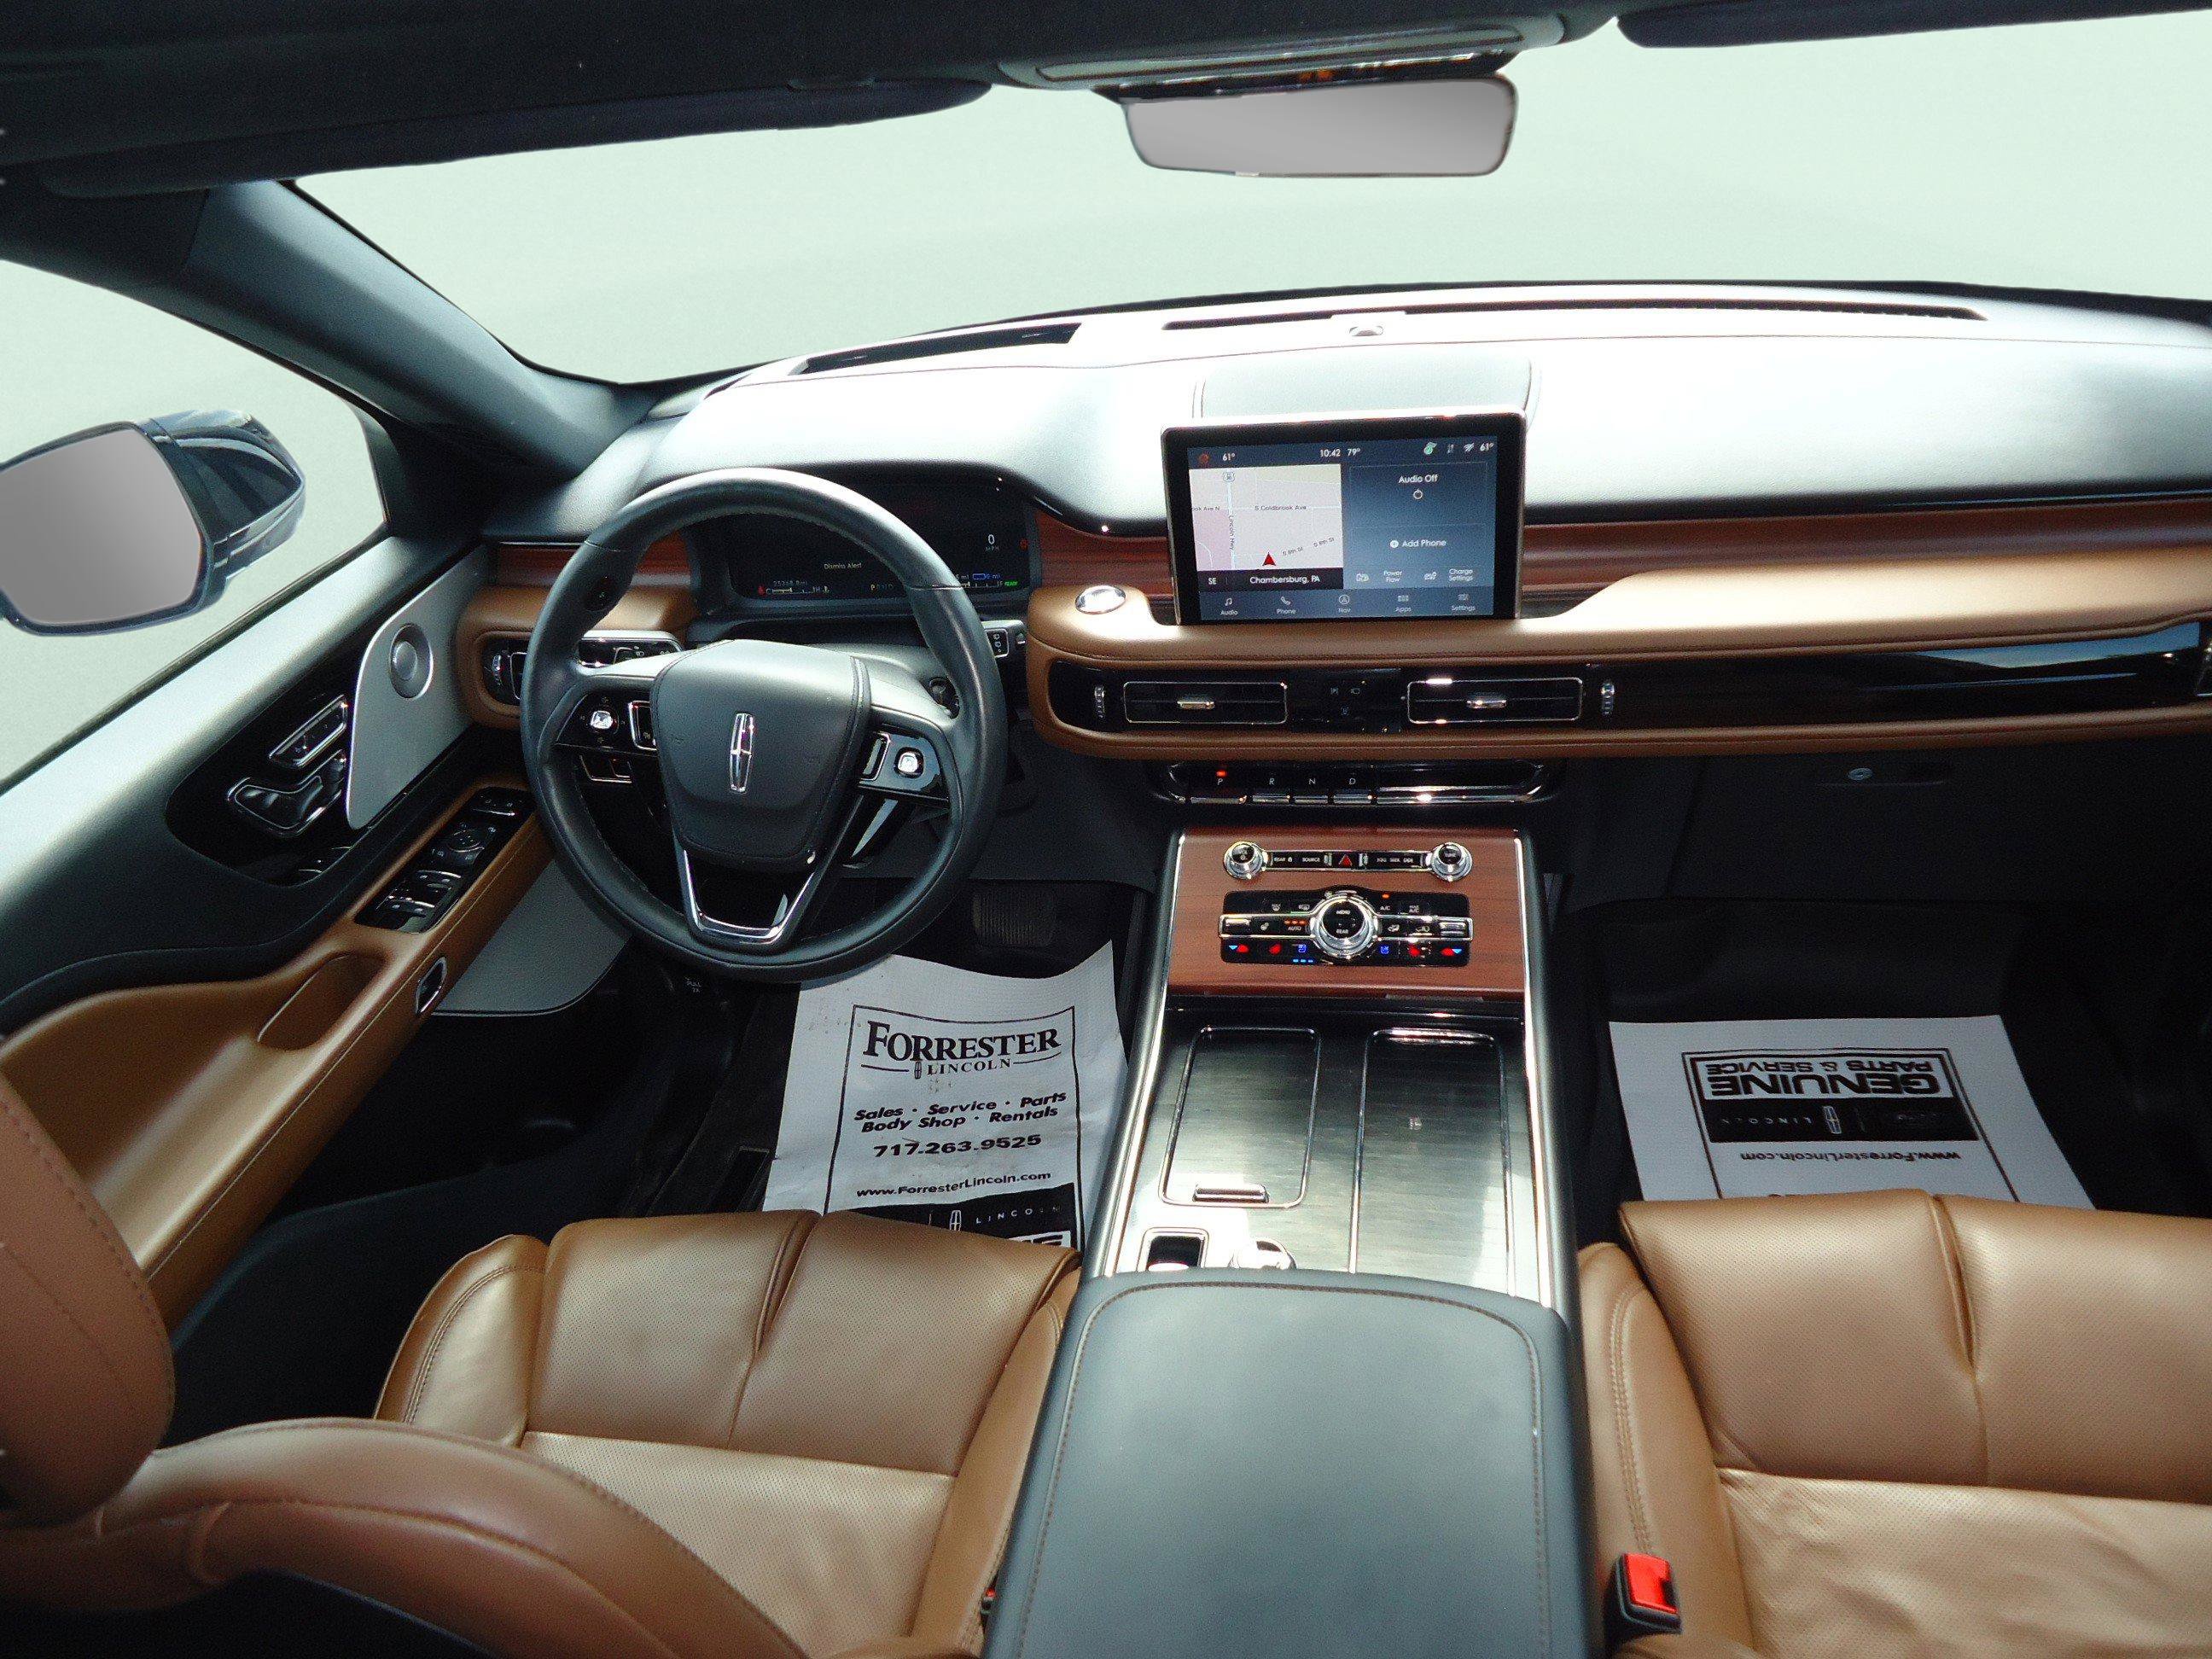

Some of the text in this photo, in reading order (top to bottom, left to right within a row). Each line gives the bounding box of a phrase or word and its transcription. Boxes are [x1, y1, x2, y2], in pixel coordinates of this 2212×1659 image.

[1319, 447, 1361, 458] 10:42 79°
[1398, 474, 1439, 484] Audio Off
[987, 533, 995, 545] 0
[1401, 538, 1447, 548] Add Phone
[1208, 577, 1217, 585] SE
[1249, 574, 1320, 585] Chambersburg, PA
[1451, 604, 1476, 613] Settings
[1217, 777, 1224, 786] P
[1268, 777, 1275, 786] R
[862, 1020, 1062, 1062] FORRESTER
[928, 1057, 1011, 1077] LINCOLN
[1707, 1059, 1933, 1075] PARTS & SERVICE
[1708, 1072, 1941, 1097] GENUINE
[853, 1091, 1067, 1121] Sales Service Parts
[861, 1106, 1058, 1134] Body Shop Rentals
[873, 1134, 1043, 1158] 717.263.9525
[1740, 1151, 1961, 1163] www.ForresterLincoln.com
[856, 1172, 1051, 1198] www.ForresterLincoln.com
[975, 1205, 1060, 1225] LINCOLN
